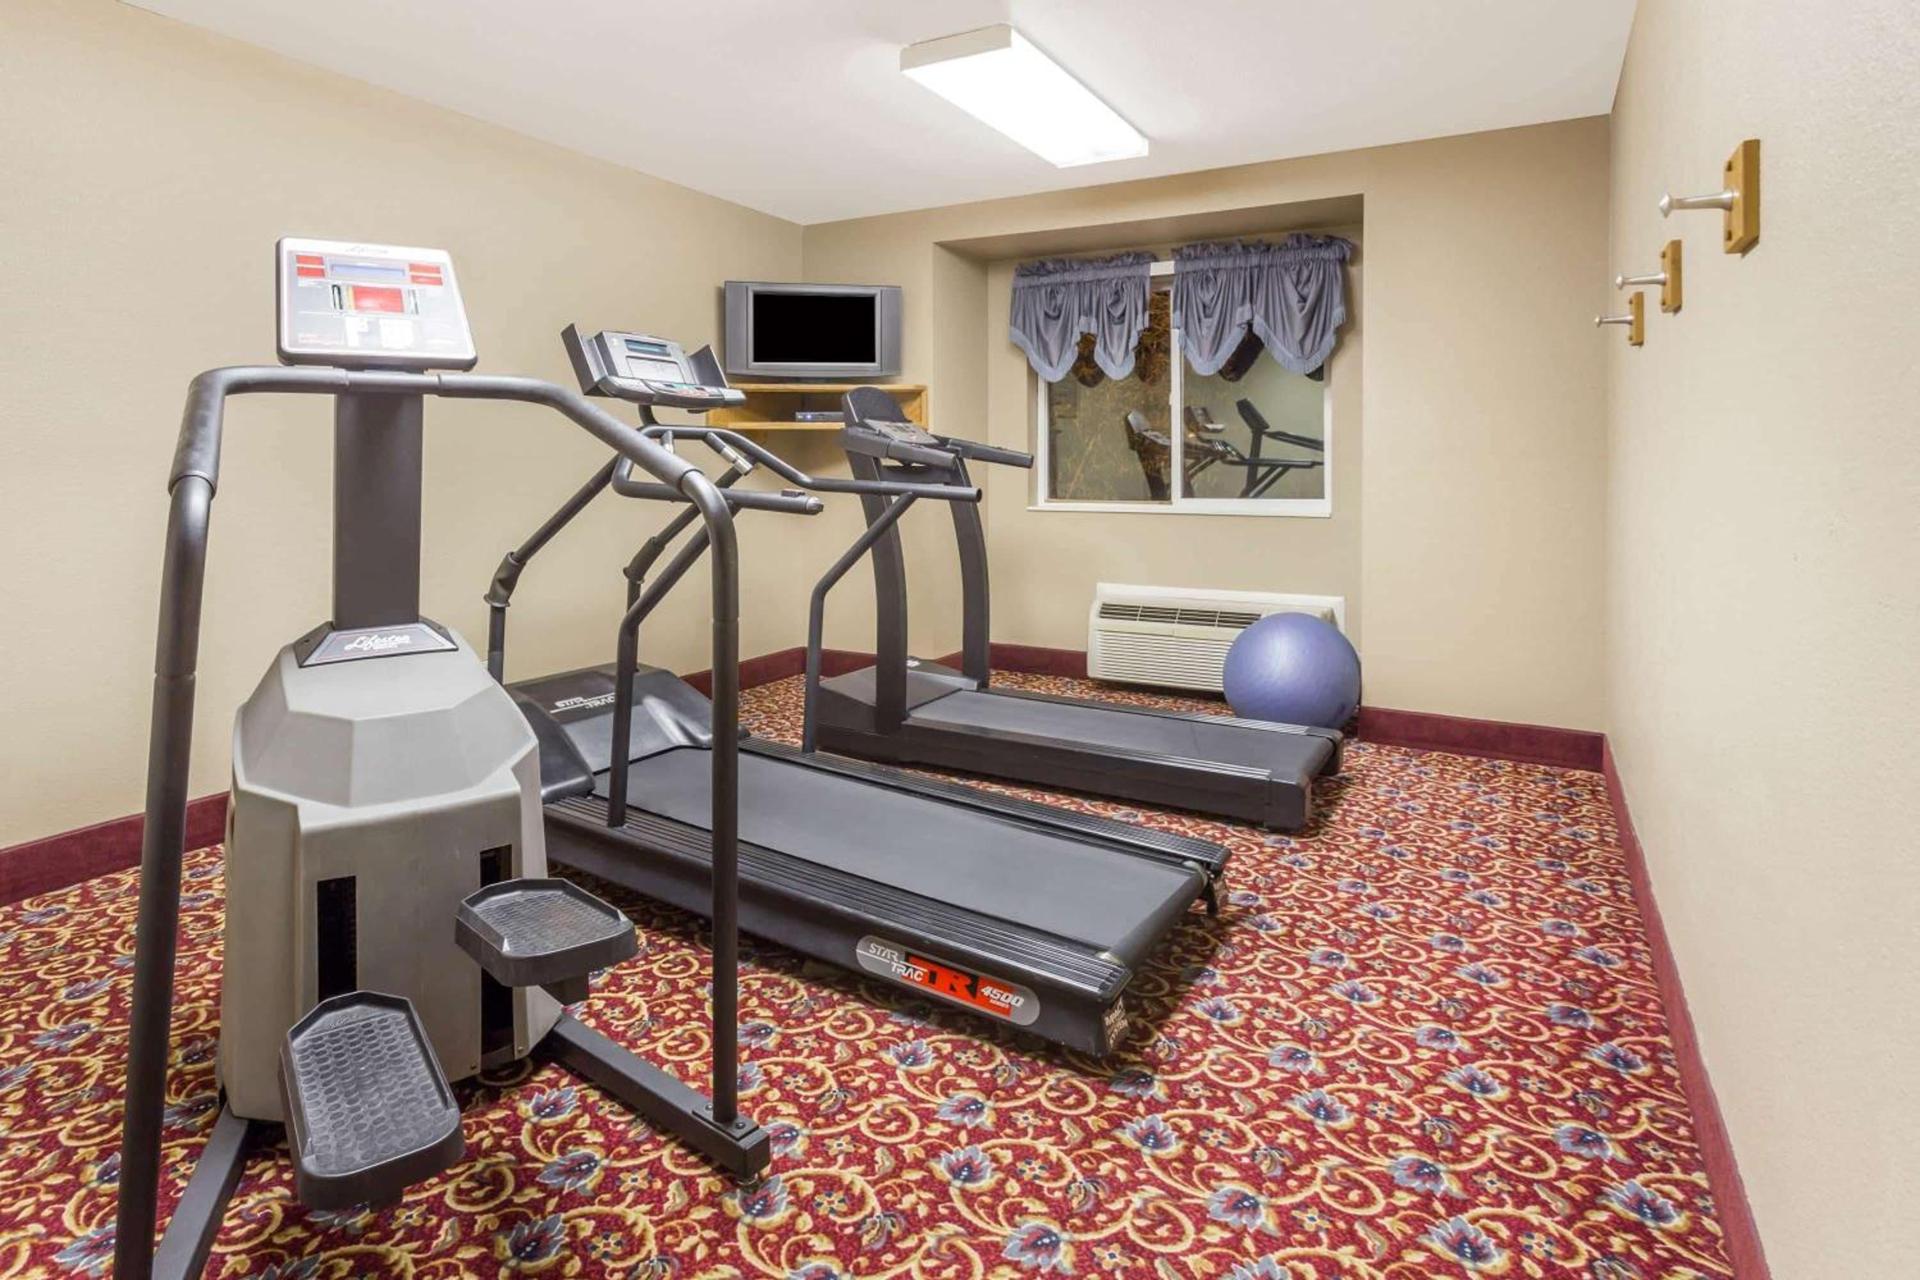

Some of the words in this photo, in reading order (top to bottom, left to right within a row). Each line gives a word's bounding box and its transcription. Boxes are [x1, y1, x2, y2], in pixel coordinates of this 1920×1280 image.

[869, 943, 898, 961] STAR
[891, 961, 923, 981] TRAC
[981, 986, 1024, 1007] 4500
